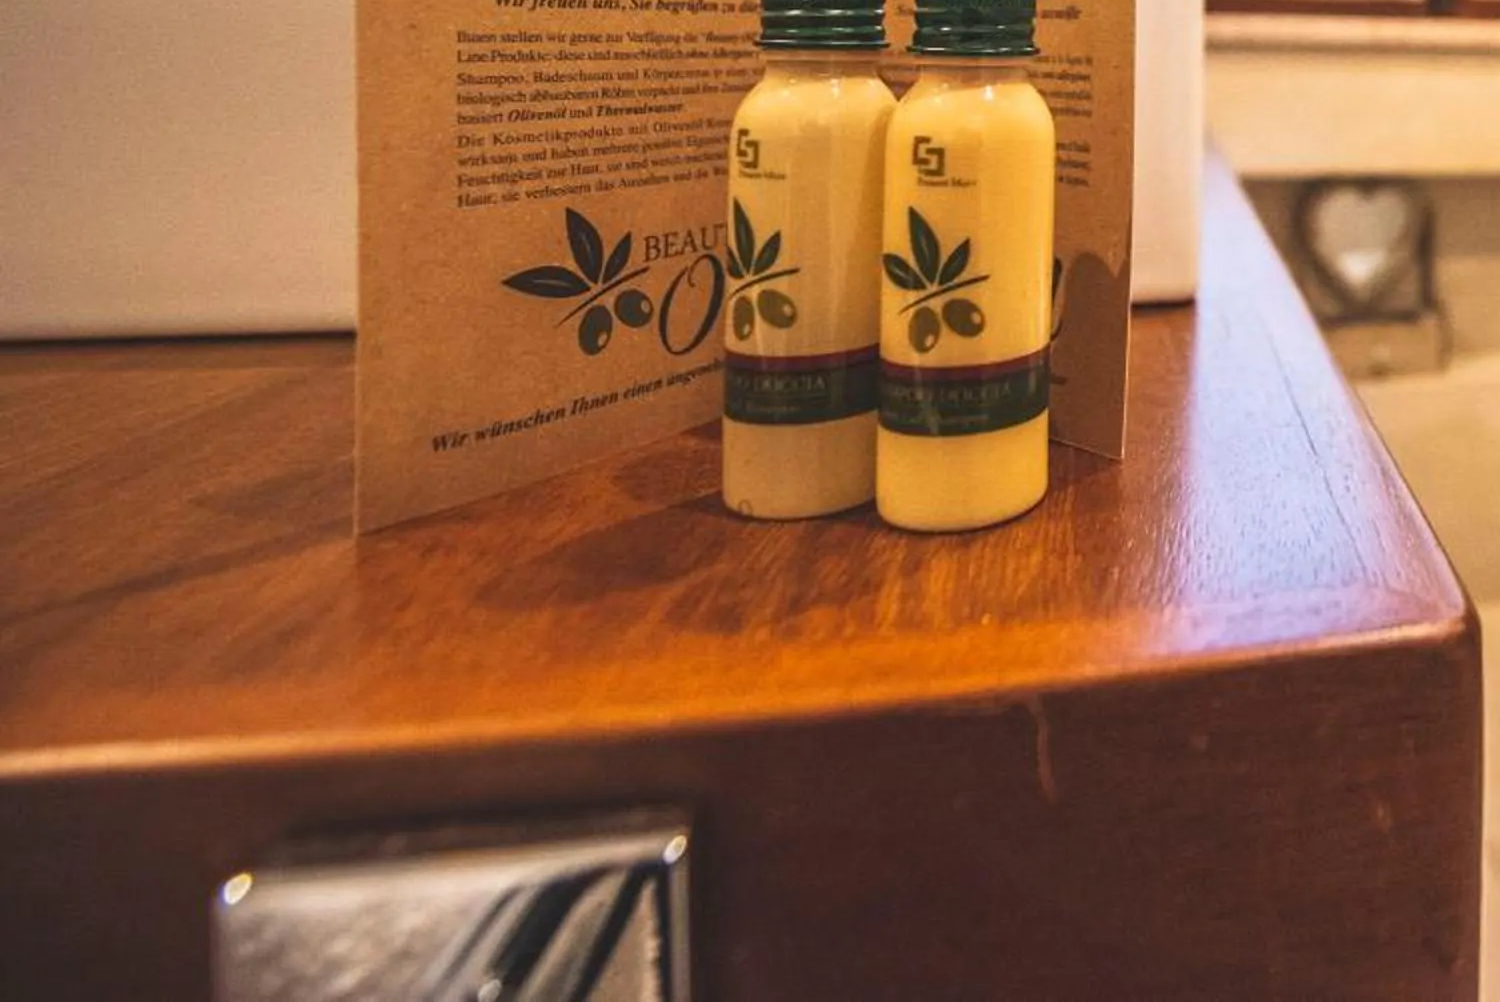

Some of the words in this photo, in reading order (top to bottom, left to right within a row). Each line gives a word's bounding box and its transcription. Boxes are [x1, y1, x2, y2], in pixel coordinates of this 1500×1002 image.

[500, 31, 543, 43] stellen
[569, 106, 593, 118] und
[457, 134, 485, 148] Die
[493, 125, 624, 147] Kosmetikprodukte
[642, 224, 729, 262] BEAU
[432, 431, 469, 452] Wir
[474, 408, 566, 439] wünschen
[570, 392, 619, 416] Ihnen
[623, 380, 663, 400] einen
